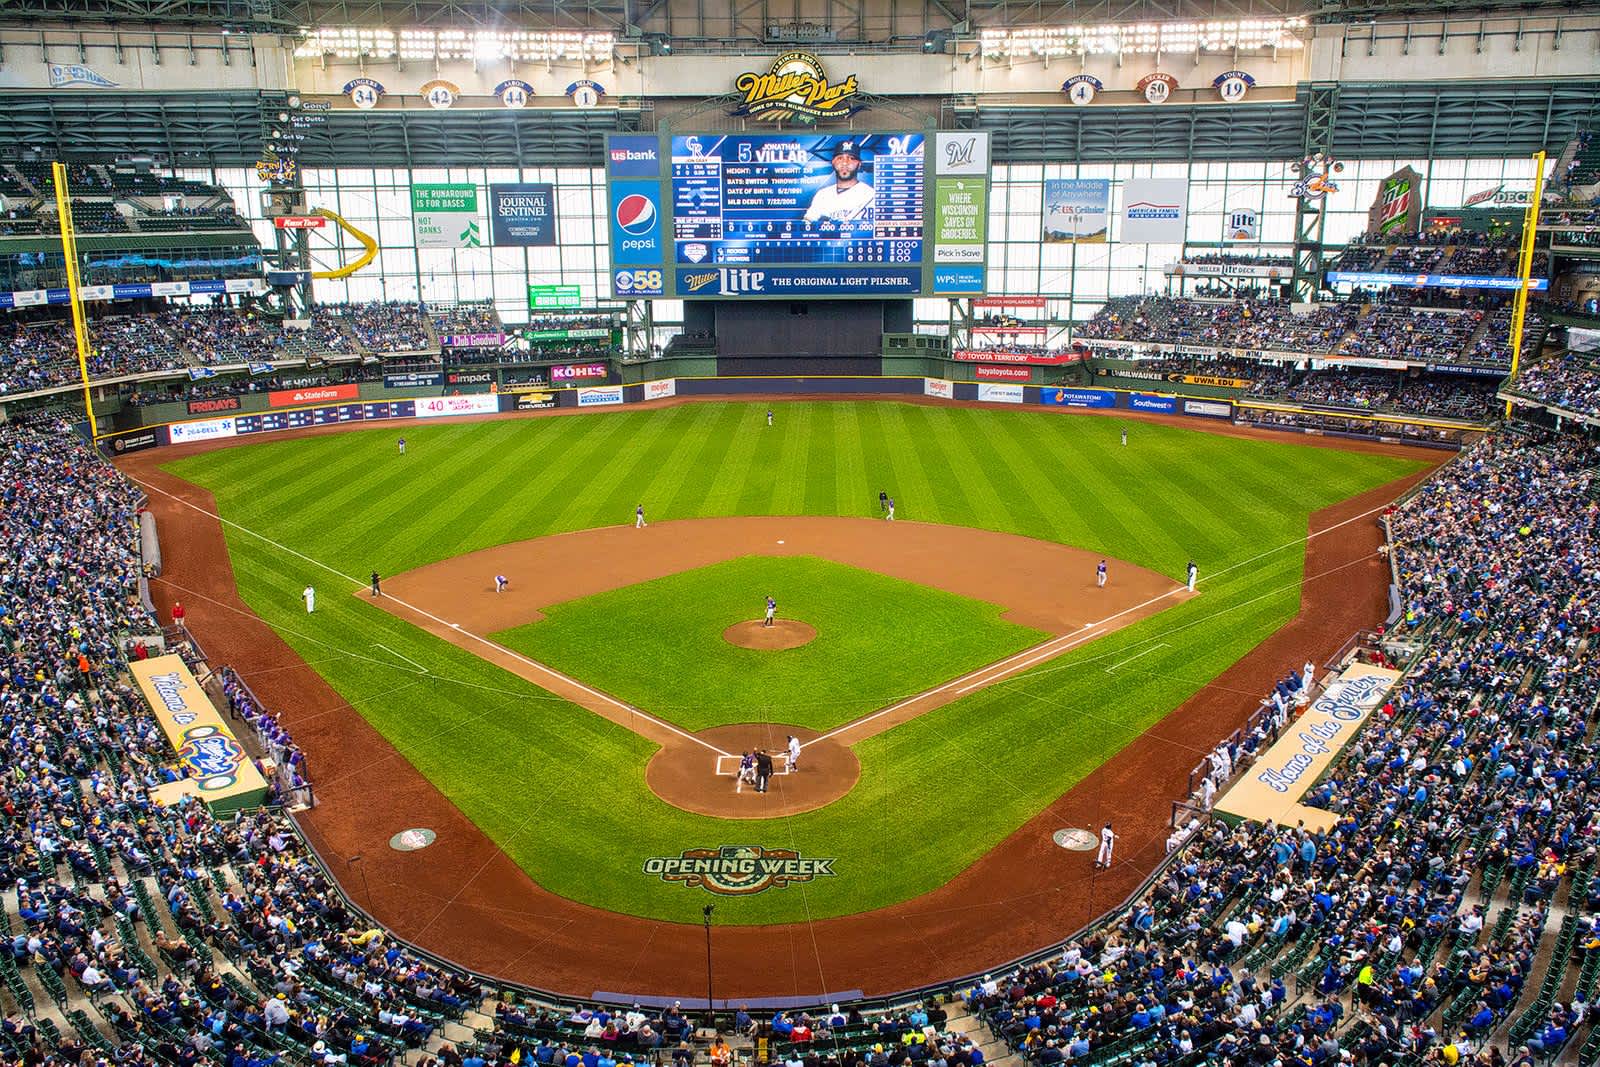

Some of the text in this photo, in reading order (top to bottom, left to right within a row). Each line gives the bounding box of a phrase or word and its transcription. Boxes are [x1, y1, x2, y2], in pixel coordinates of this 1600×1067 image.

[350, 78, 378, 89] FINGERS
[1068, 75, 1097, 85] MOLITOR
[736, 71, 858, 106] Miller Park
[1077, 86, 1085, 99] 4
[1150, 83, 1165, 94] 50
[1224, 83, 1242, 97] 19
[355, 90, 375, 104] 34
[431, 91, 450, 103] 42
[505, 91, 524, 103] 44
[582, 91, 589, 103] 1
[738, 143, 752, 163] 5
[756, 150, 808, 162] VILLAR
[415, 190, 474, 198] THE RUNAROUND
[949, 193, 972, 203] WHERE
[416, 200, 465, 208] IS FOR BASES
[499, 197, 547, 207] JOURNAL
[499, 207, 548, 216] SENTINEL
[941, 205, 978, 215] WISCONSIN
[944, 217, 976, 227] SAVES ON
[1231, 214, 1254, 229] Lite
[622, 238, 655, 251] pepsi
[938, 249, 953, 257] Pick
[633, 270, 662, 290] 58
[684, 272, 720, 291] Miller
[718, 268, 765, 295] Lite
[936, 275, 956, 283] WPS
[994, 353, 1028, 361] TERRITORY
[553, 365, 606, 377] KOHL'S
[458, 373, 491, 384] impact
[1193, 376, 1234, 386] UWM.EDU
[189, 399, 237, 413] FRIDAYS
[428, 400, 444, 411] 40
[1133, 399, 1167, 409] Southwest
[1258, 675, 1392, 793] Home of the Brewers
[645, 858, 830, 874] OPENING WEEK
